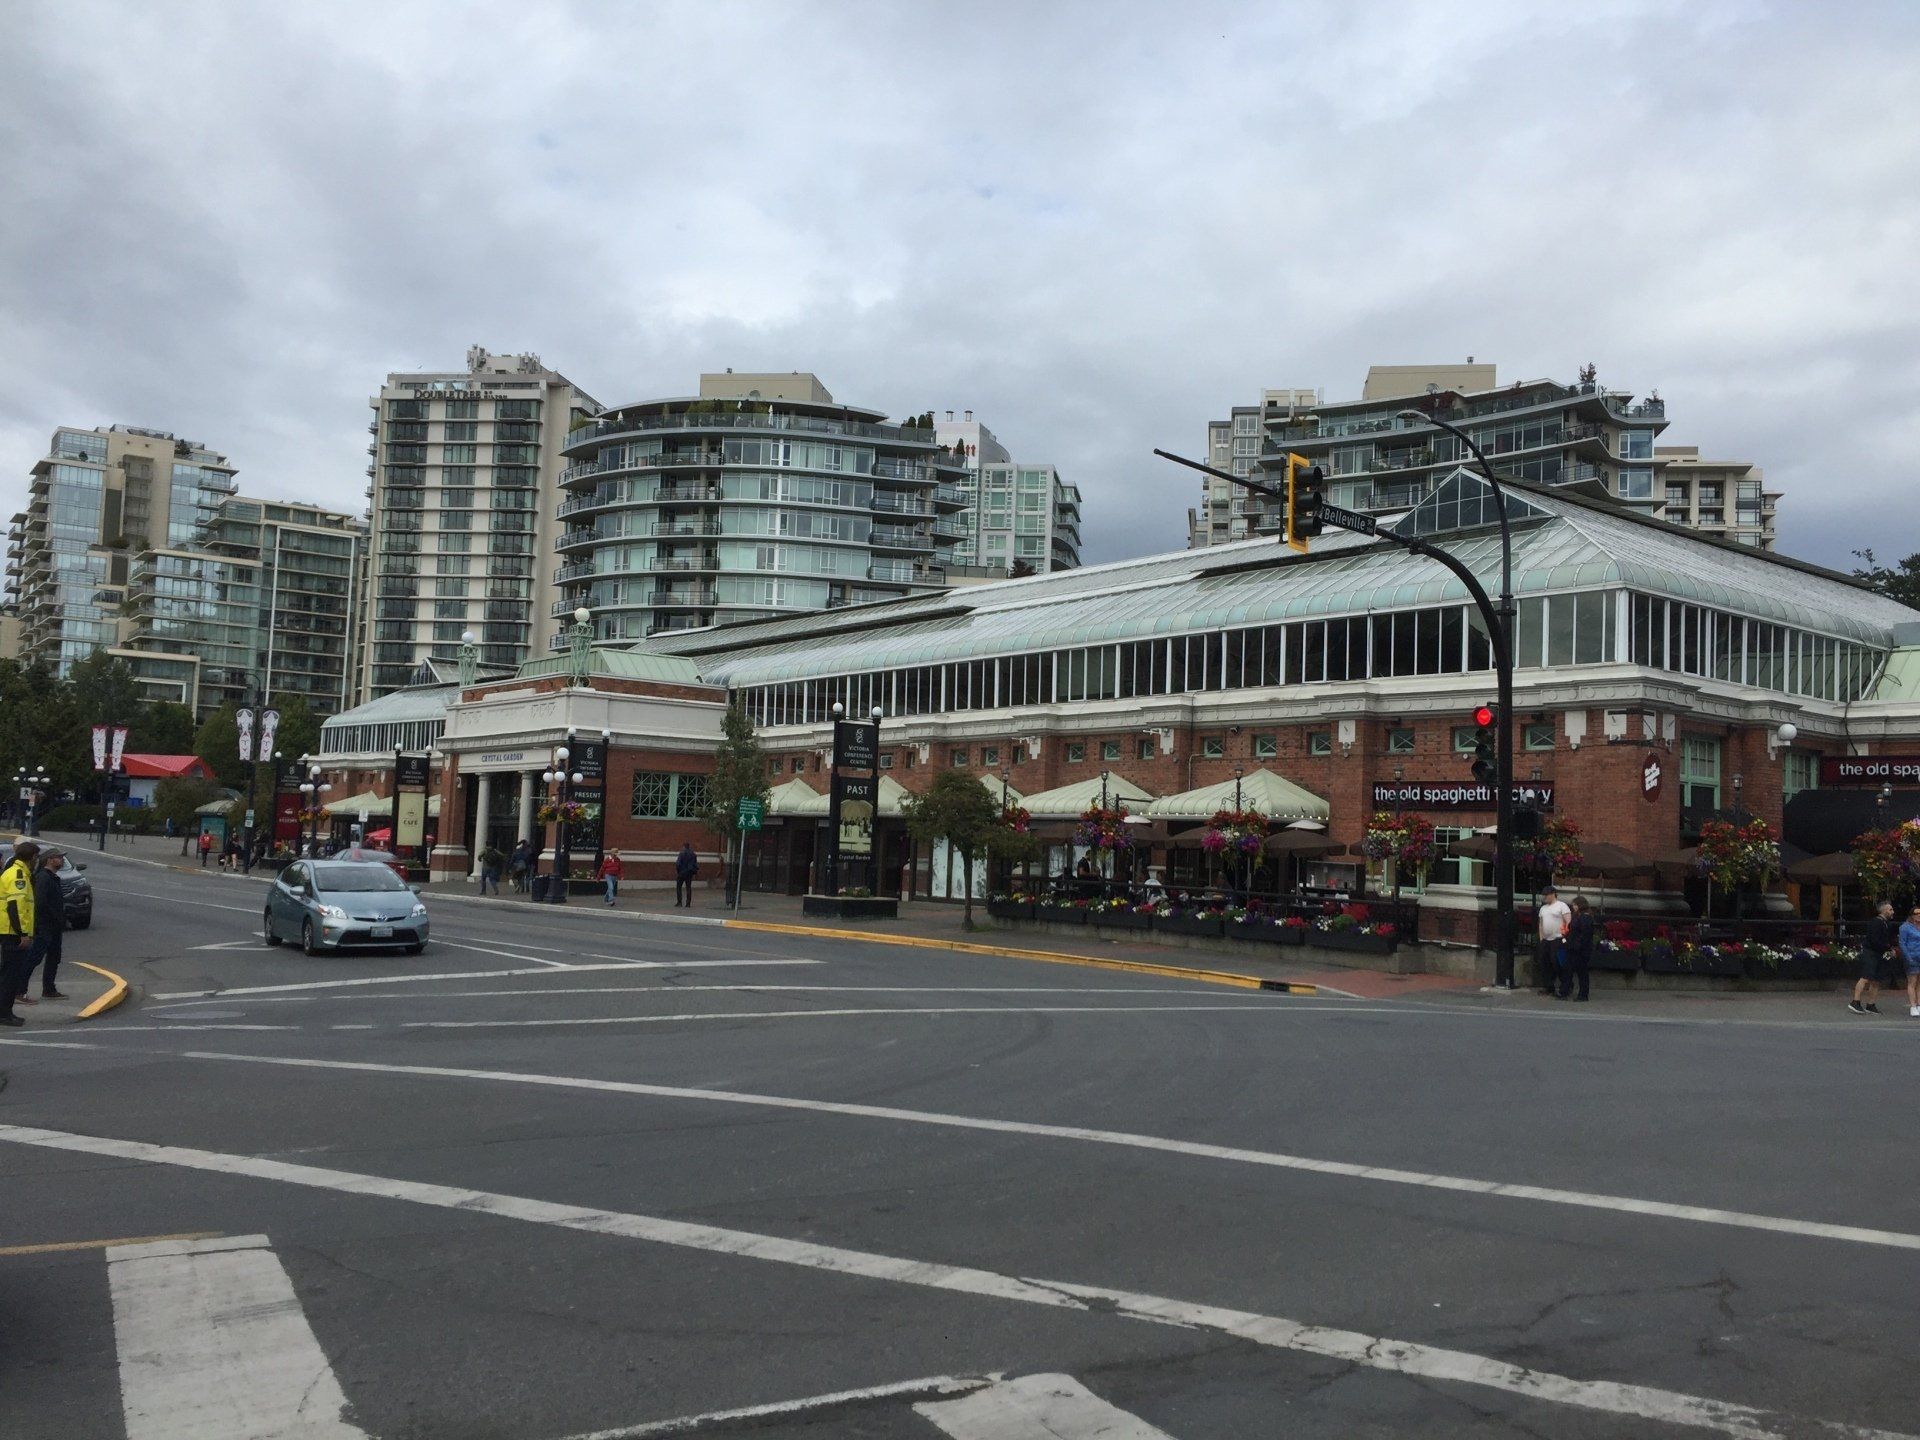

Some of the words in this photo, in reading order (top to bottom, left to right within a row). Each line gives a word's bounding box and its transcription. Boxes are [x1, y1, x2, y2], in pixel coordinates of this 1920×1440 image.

[1325, 508, 1366, 530] Belleville
[849, 744, 870, 752] VICTORIA
[481, 754, 502, 762] CRYSTAL
[503, 753, 523, 761] GARDEN
[844, 751, 873, 759] CONFERENCE
[1839, 763, 1863, 776] the
[1866, 762, 1889, 775] old
[847, 785, 869, 796] PAST
[1375, 786, 1396, 801] the
[1399, 786, 1420, 801] old
[1424, 785, 1491, 804] spaghetti
